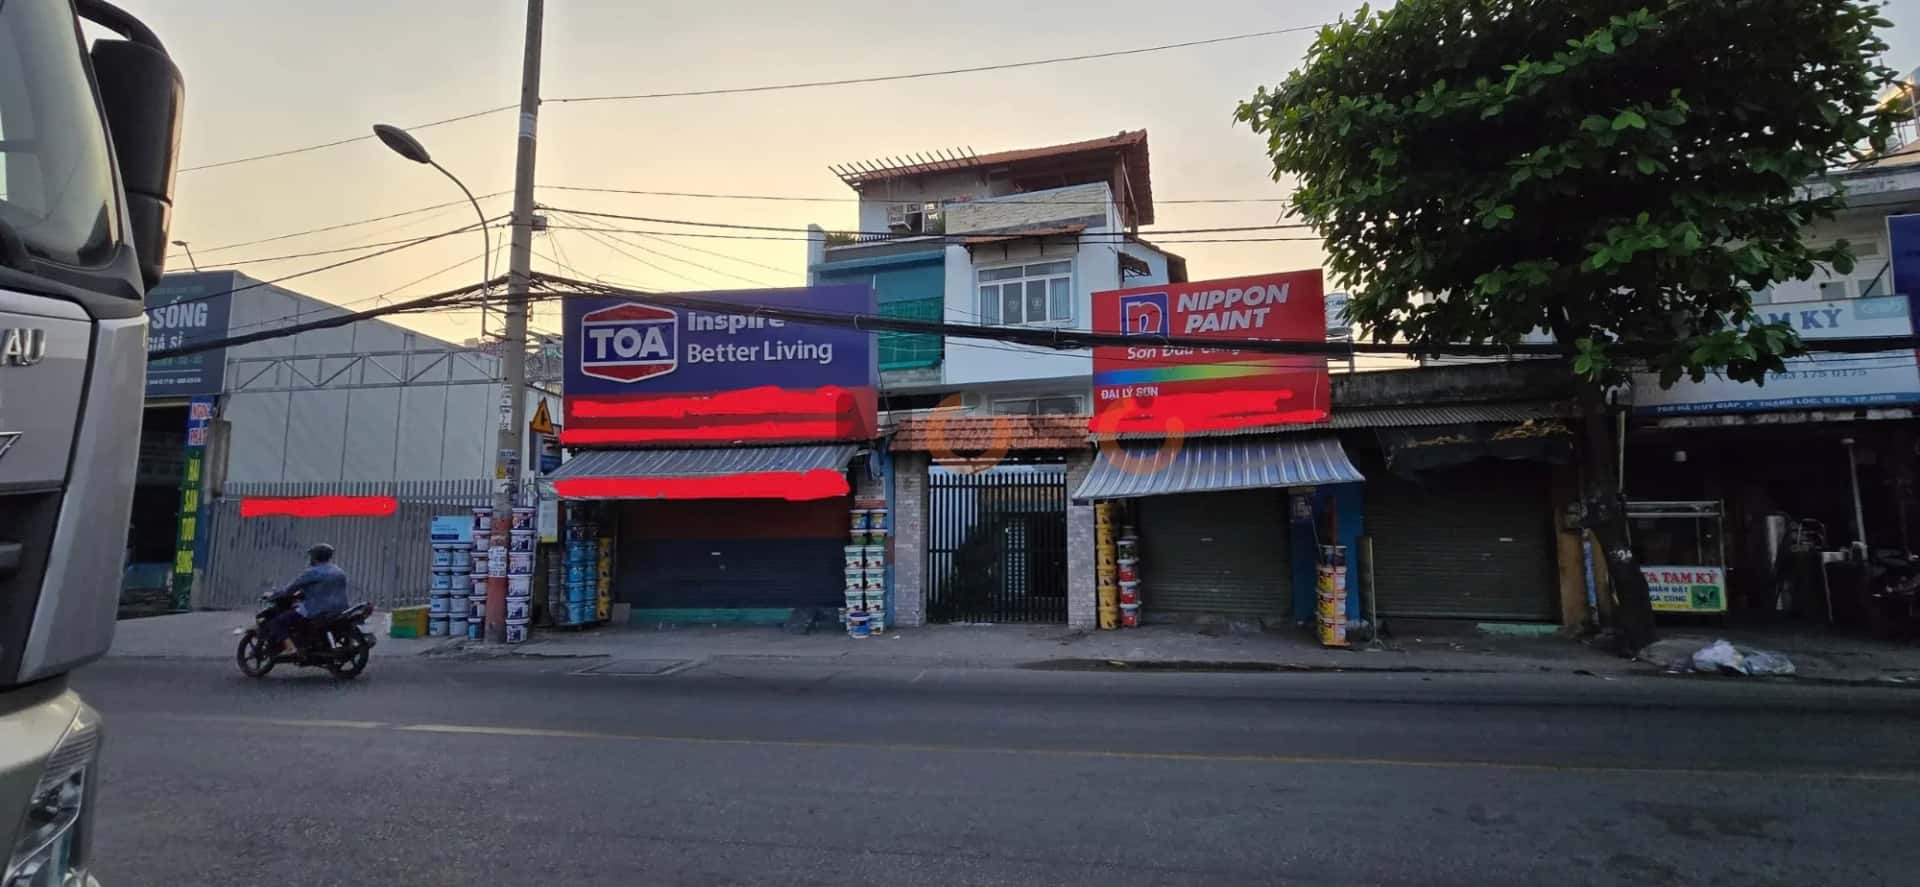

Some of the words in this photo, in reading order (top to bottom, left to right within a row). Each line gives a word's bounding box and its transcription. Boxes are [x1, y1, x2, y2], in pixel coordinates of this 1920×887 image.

[151, 295, 209, 329] SỐNG
[1177, 283, 1290, 313] NIPPON
[1185, 307, 1270, 334] PAINT
[1800, 303, 1843, 330] KỲ
[588, 326, 669, 360] TOA
[687, 342, 760, 364] Better
[763, 340, 834, 365] Living
